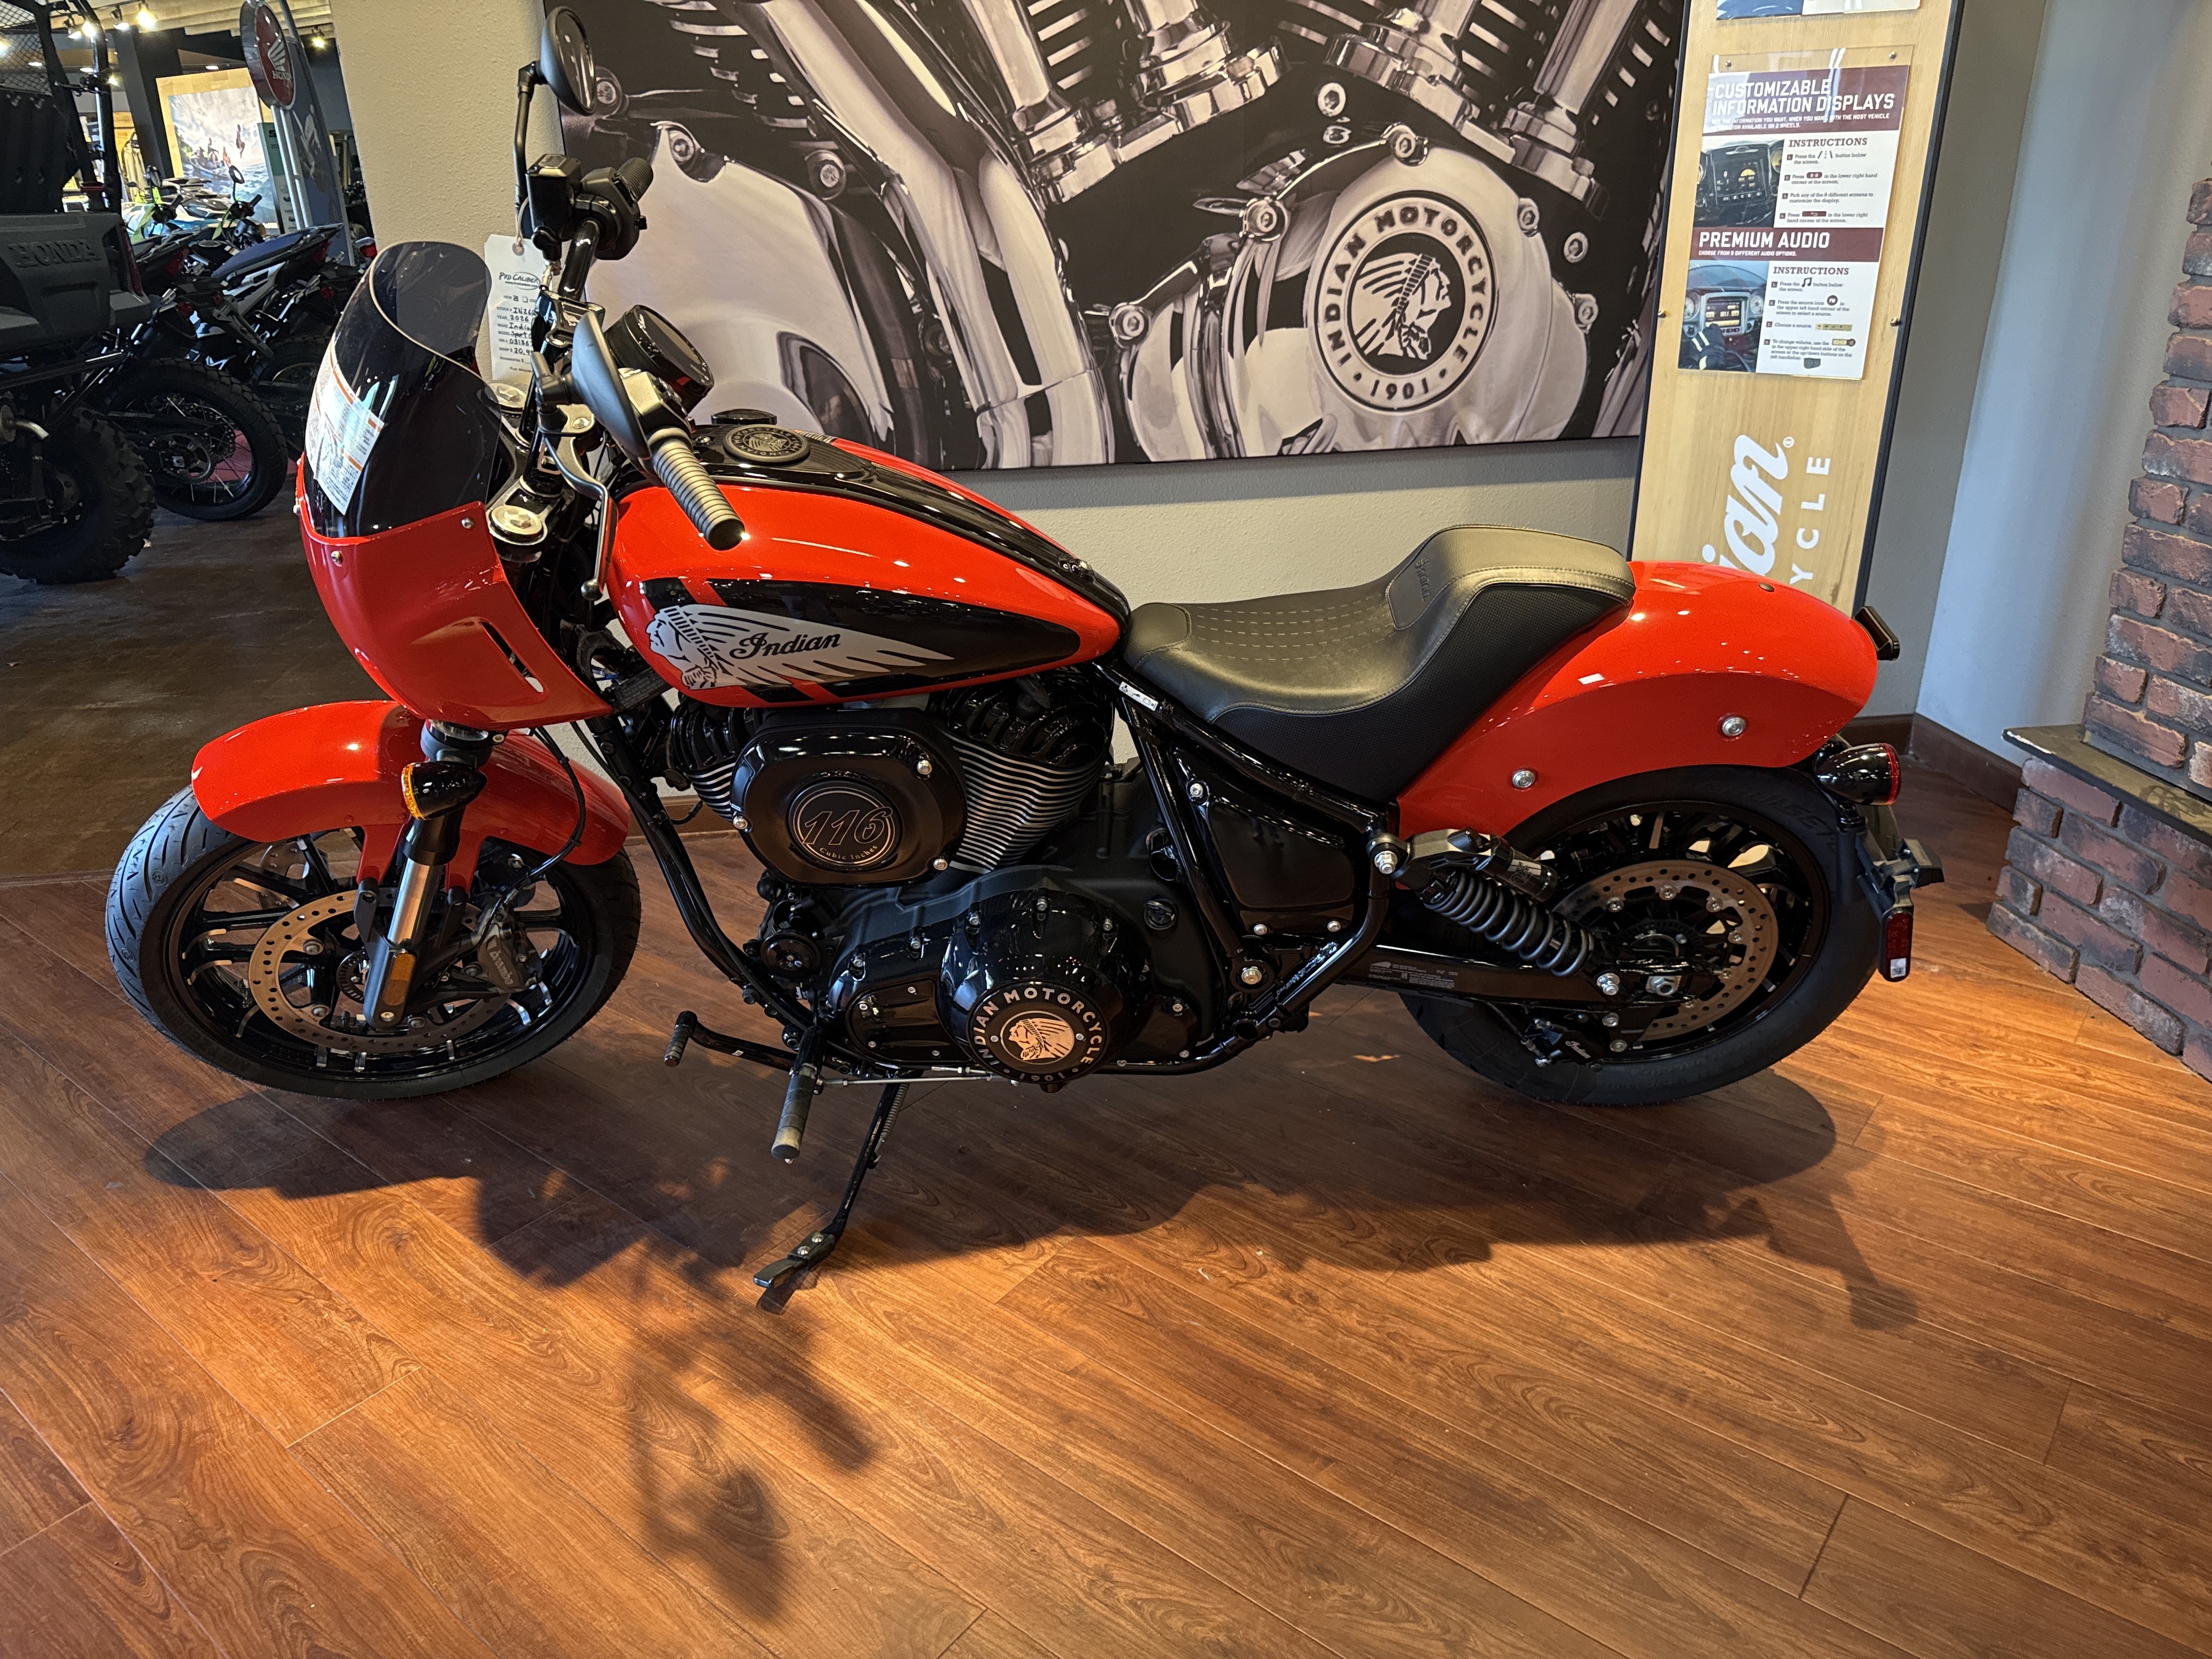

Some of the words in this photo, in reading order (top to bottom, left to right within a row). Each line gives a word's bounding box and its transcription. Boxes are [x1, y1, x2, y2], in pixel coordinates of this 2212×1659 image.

[1714, 78, 1832, 99] CUSTOMIZABLE
[1712, 97, 1812, 116] INFORMATION
[1816, 93, 1895, 112] DISPLAYS
[1788, 138, 1867, 147] INSTRUCTIONS
[1699, 232, 1774, 248] PREMIUM
[1778, 232, 1830, 248] AUDIO
[7, 238, 101, 268] HONDA
[1773, 267, 1849, 275] INSTRUCTIONS
[1325, 233, 1366, 366] INDIAN
[1374, 206, 1486, 363] MOTORCYCLE
[1370, 378, 1429, 400] 1901
[735, 428, 792, 444] MOTORCYCLE
[740, 445, 782, 456] INDIAN
[730, 633, 842, 658] Indian
[802, 806, 893, 845] 116
[820, 848, 847, 860] Cubic
[850, 844, 878, 860] Inches
[973, 1001, 1000, 1065] INDIAN
[1003, 988, 1103, 1064] MOTORCYCLE
[1019, 1073, 1065, 1081] 1901
